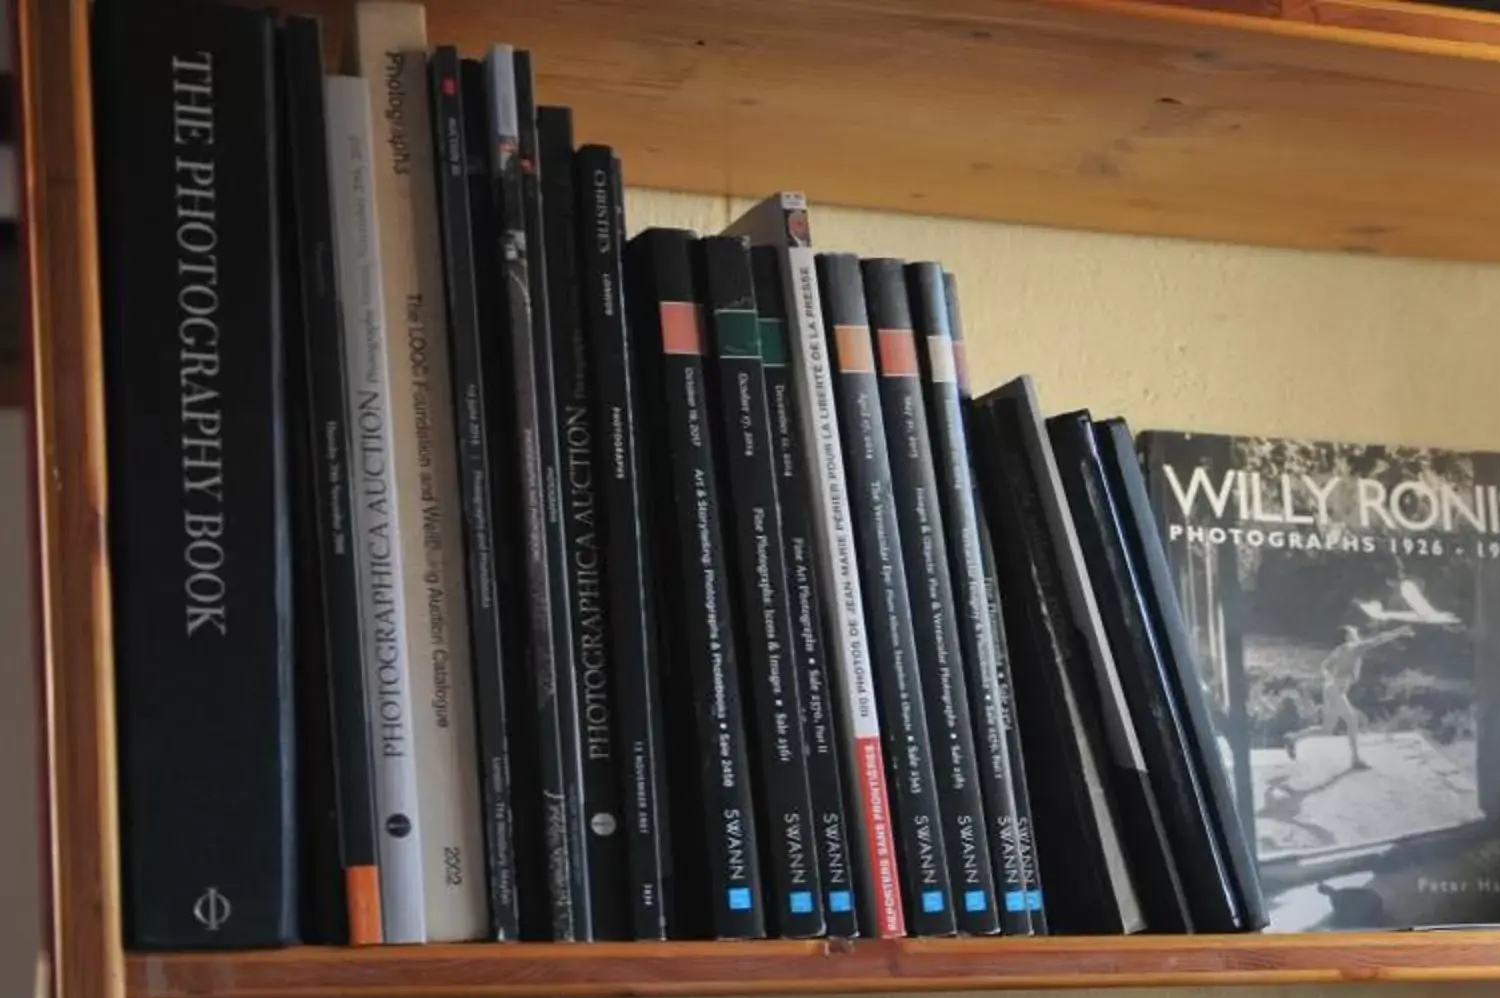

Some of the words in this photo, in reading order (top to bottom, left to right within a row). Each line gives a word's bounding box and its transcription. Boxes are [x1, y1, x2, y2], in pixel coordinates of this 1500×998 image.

[172, 52, 214, 146] THE
[407, 293, 424, 323] The
[798, 266, 816, 318] PRESSE
[175, 160, 225, 501] PHOTOGRAPHY
[806, 320, 820, 339] LA
[809, 341, 822, 360] DE
[682, 367, 700, 407] October
[737, 371, 753, 411] October
[818, 422, 833, 439] LA
[356, 389, 389, 520] AUCTION
[563, 404, 597, 518] AUCTION
[823, 443, 838, 479] POUR
[420, 471, 435, 500] and
[692, 467, 706, 486] Art
[694, 489, 705, 498] &
[870, 481, 882, 501] The
[1162, 464, 1342, 526] WILLY
[751, 505, 765, 533] Fine
[790, 537, 805, 562] Fine
[835, 537, 851, 577] MARIE
[1168, 524, 1377, 554] PHOTOGRAPHS
[1390, 537, 1445, 556] 1926
[183, 513, 227, 638] BOOK
[796, 564, 808, 582] Art
[428, 587, 449, 646] Auction
[702, 568, 720, 639] Photographs
[840, 580, 857, 615] JEAN
[797, 586, 818, 653] Photographs
[844, 621, 859, 639] DE
[362, 526, 406, 760] PHOTOGRAPHICA
[807, 668, 821, 692] Sale
[849, 641, 867, 694] PHOTOS
[430, 650, 453, 729] Catalogue
[907, 744, 922, 768] Sale
[722, 807, 747, 881] SWANN
[782, 811, 808, 885] SWANN
[820, 811, 845, 885] SWANN
[872, 823, 890, 857] SANS
[912, 814, 938, 885] SWANN
[956, 814, 980, 885] SWANN
[996, 814, 1020, 885] SWANN
[1015, 815, 1037, 885] SWANN
[445, 847, 462, 888] 2002
[1416, 876, 1470, 894] Peter
